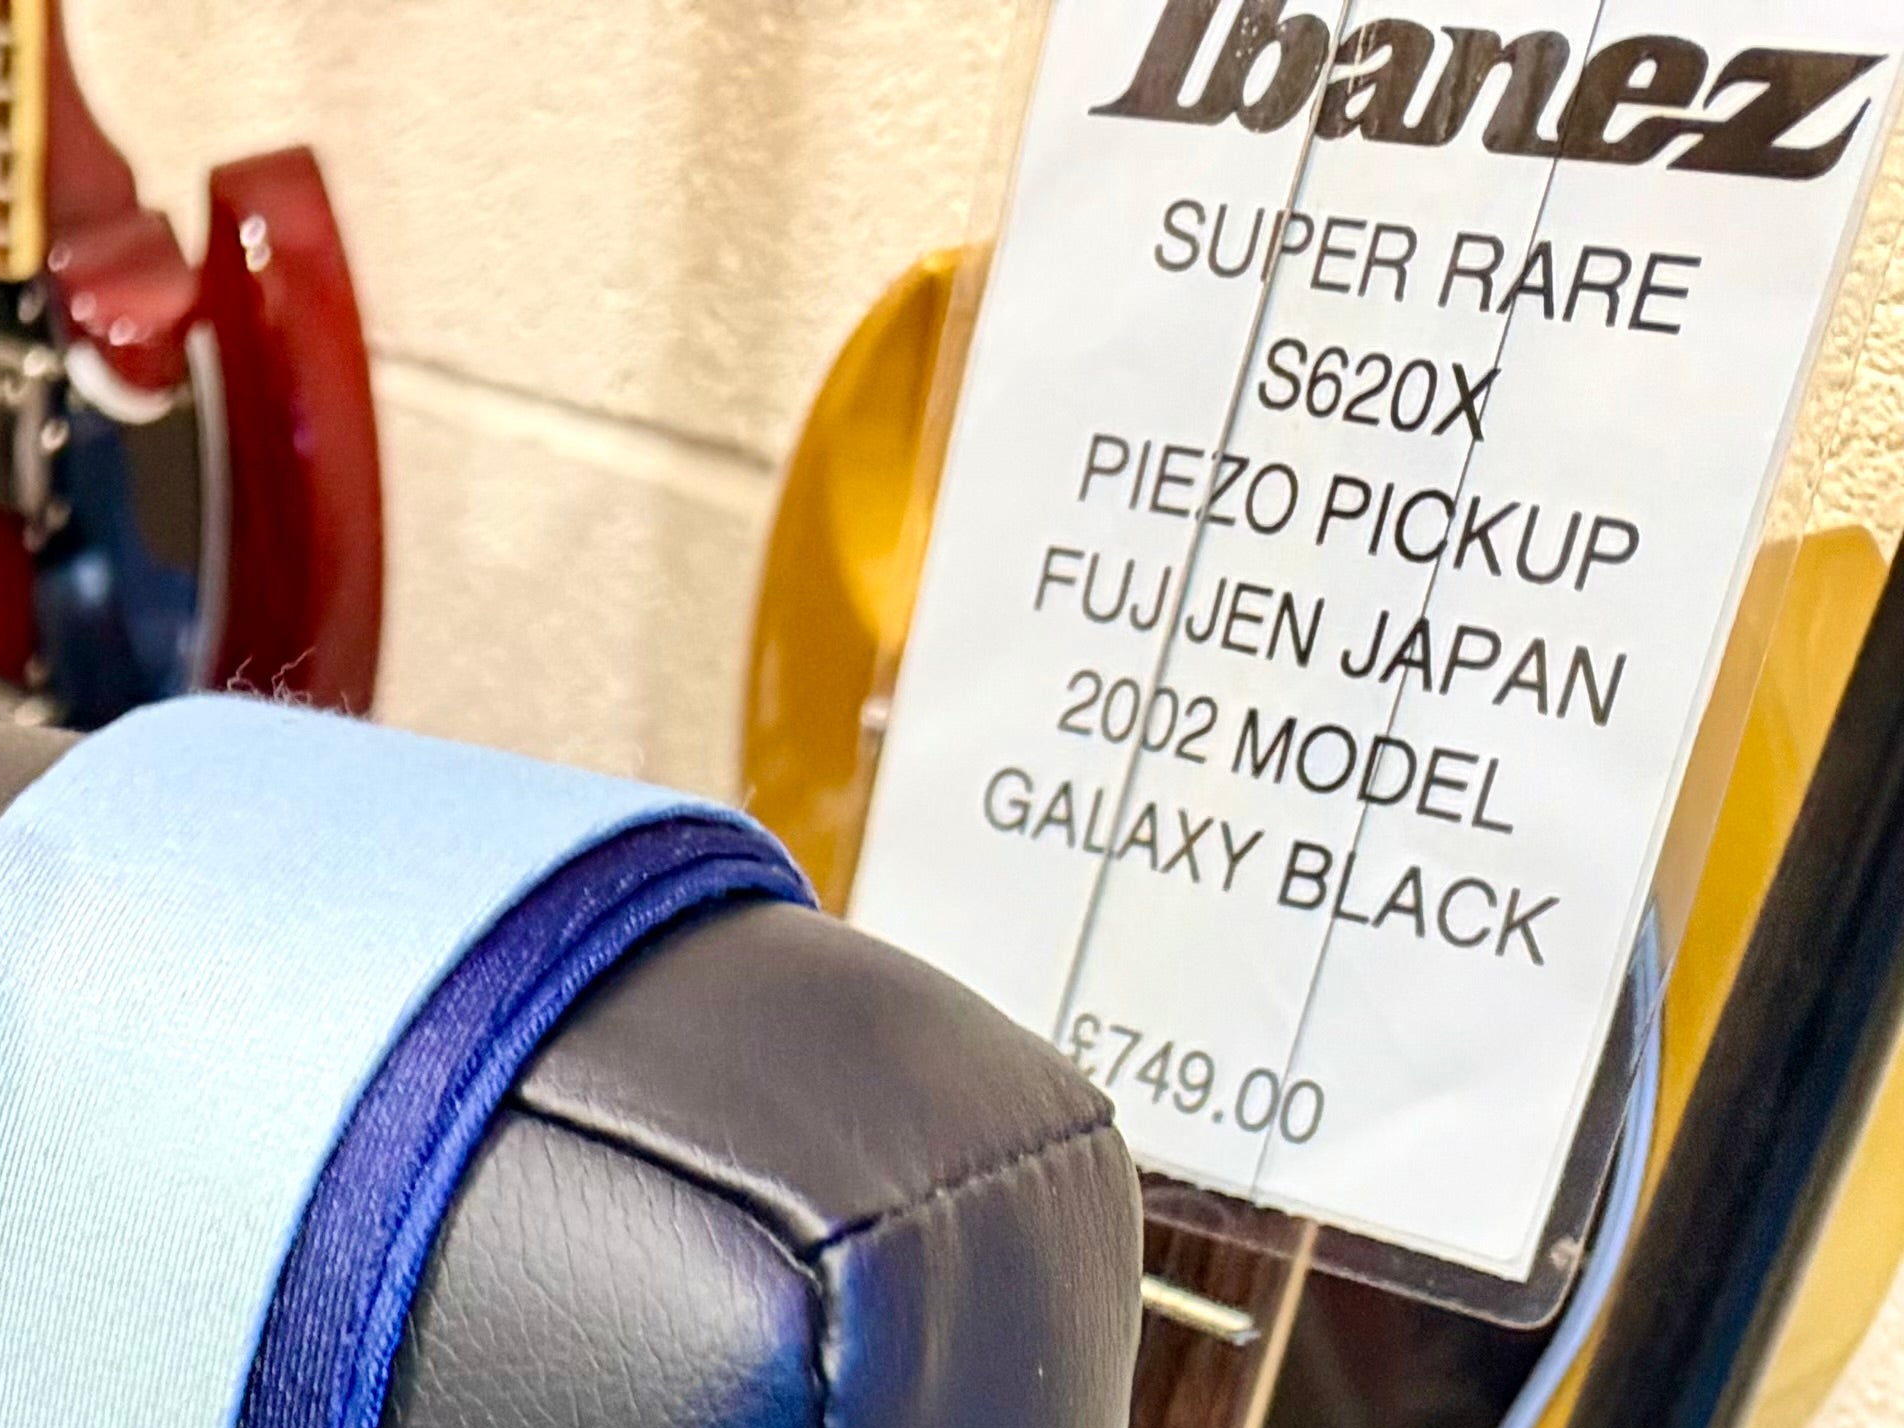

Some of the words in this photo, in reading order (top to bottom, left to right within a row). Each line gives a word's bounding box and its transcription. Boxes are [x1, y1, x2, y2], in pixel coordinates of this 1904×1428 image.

[1087, 0, 1889, 181] Ibanez
[1153, 199, 1418, 302] SUPER
[1438, 231, 1702, 335] RARE
[1257, 336, 1500, 442] S620X
[1077, 432, 1299, 535] PIEZO
[1316, 475, 1641, 592] PICKUP
[1340, 610, 1627, 727] JAPAN
[1057, 668, 1219, 764] 2002
[1230, 707, 1514, 835] MODEL
[982, 766, 1264, 893] GALAXY
[1277, 839, 1561, 966] BLACK
[1062, 1012, 1325, 1145] £749.00
